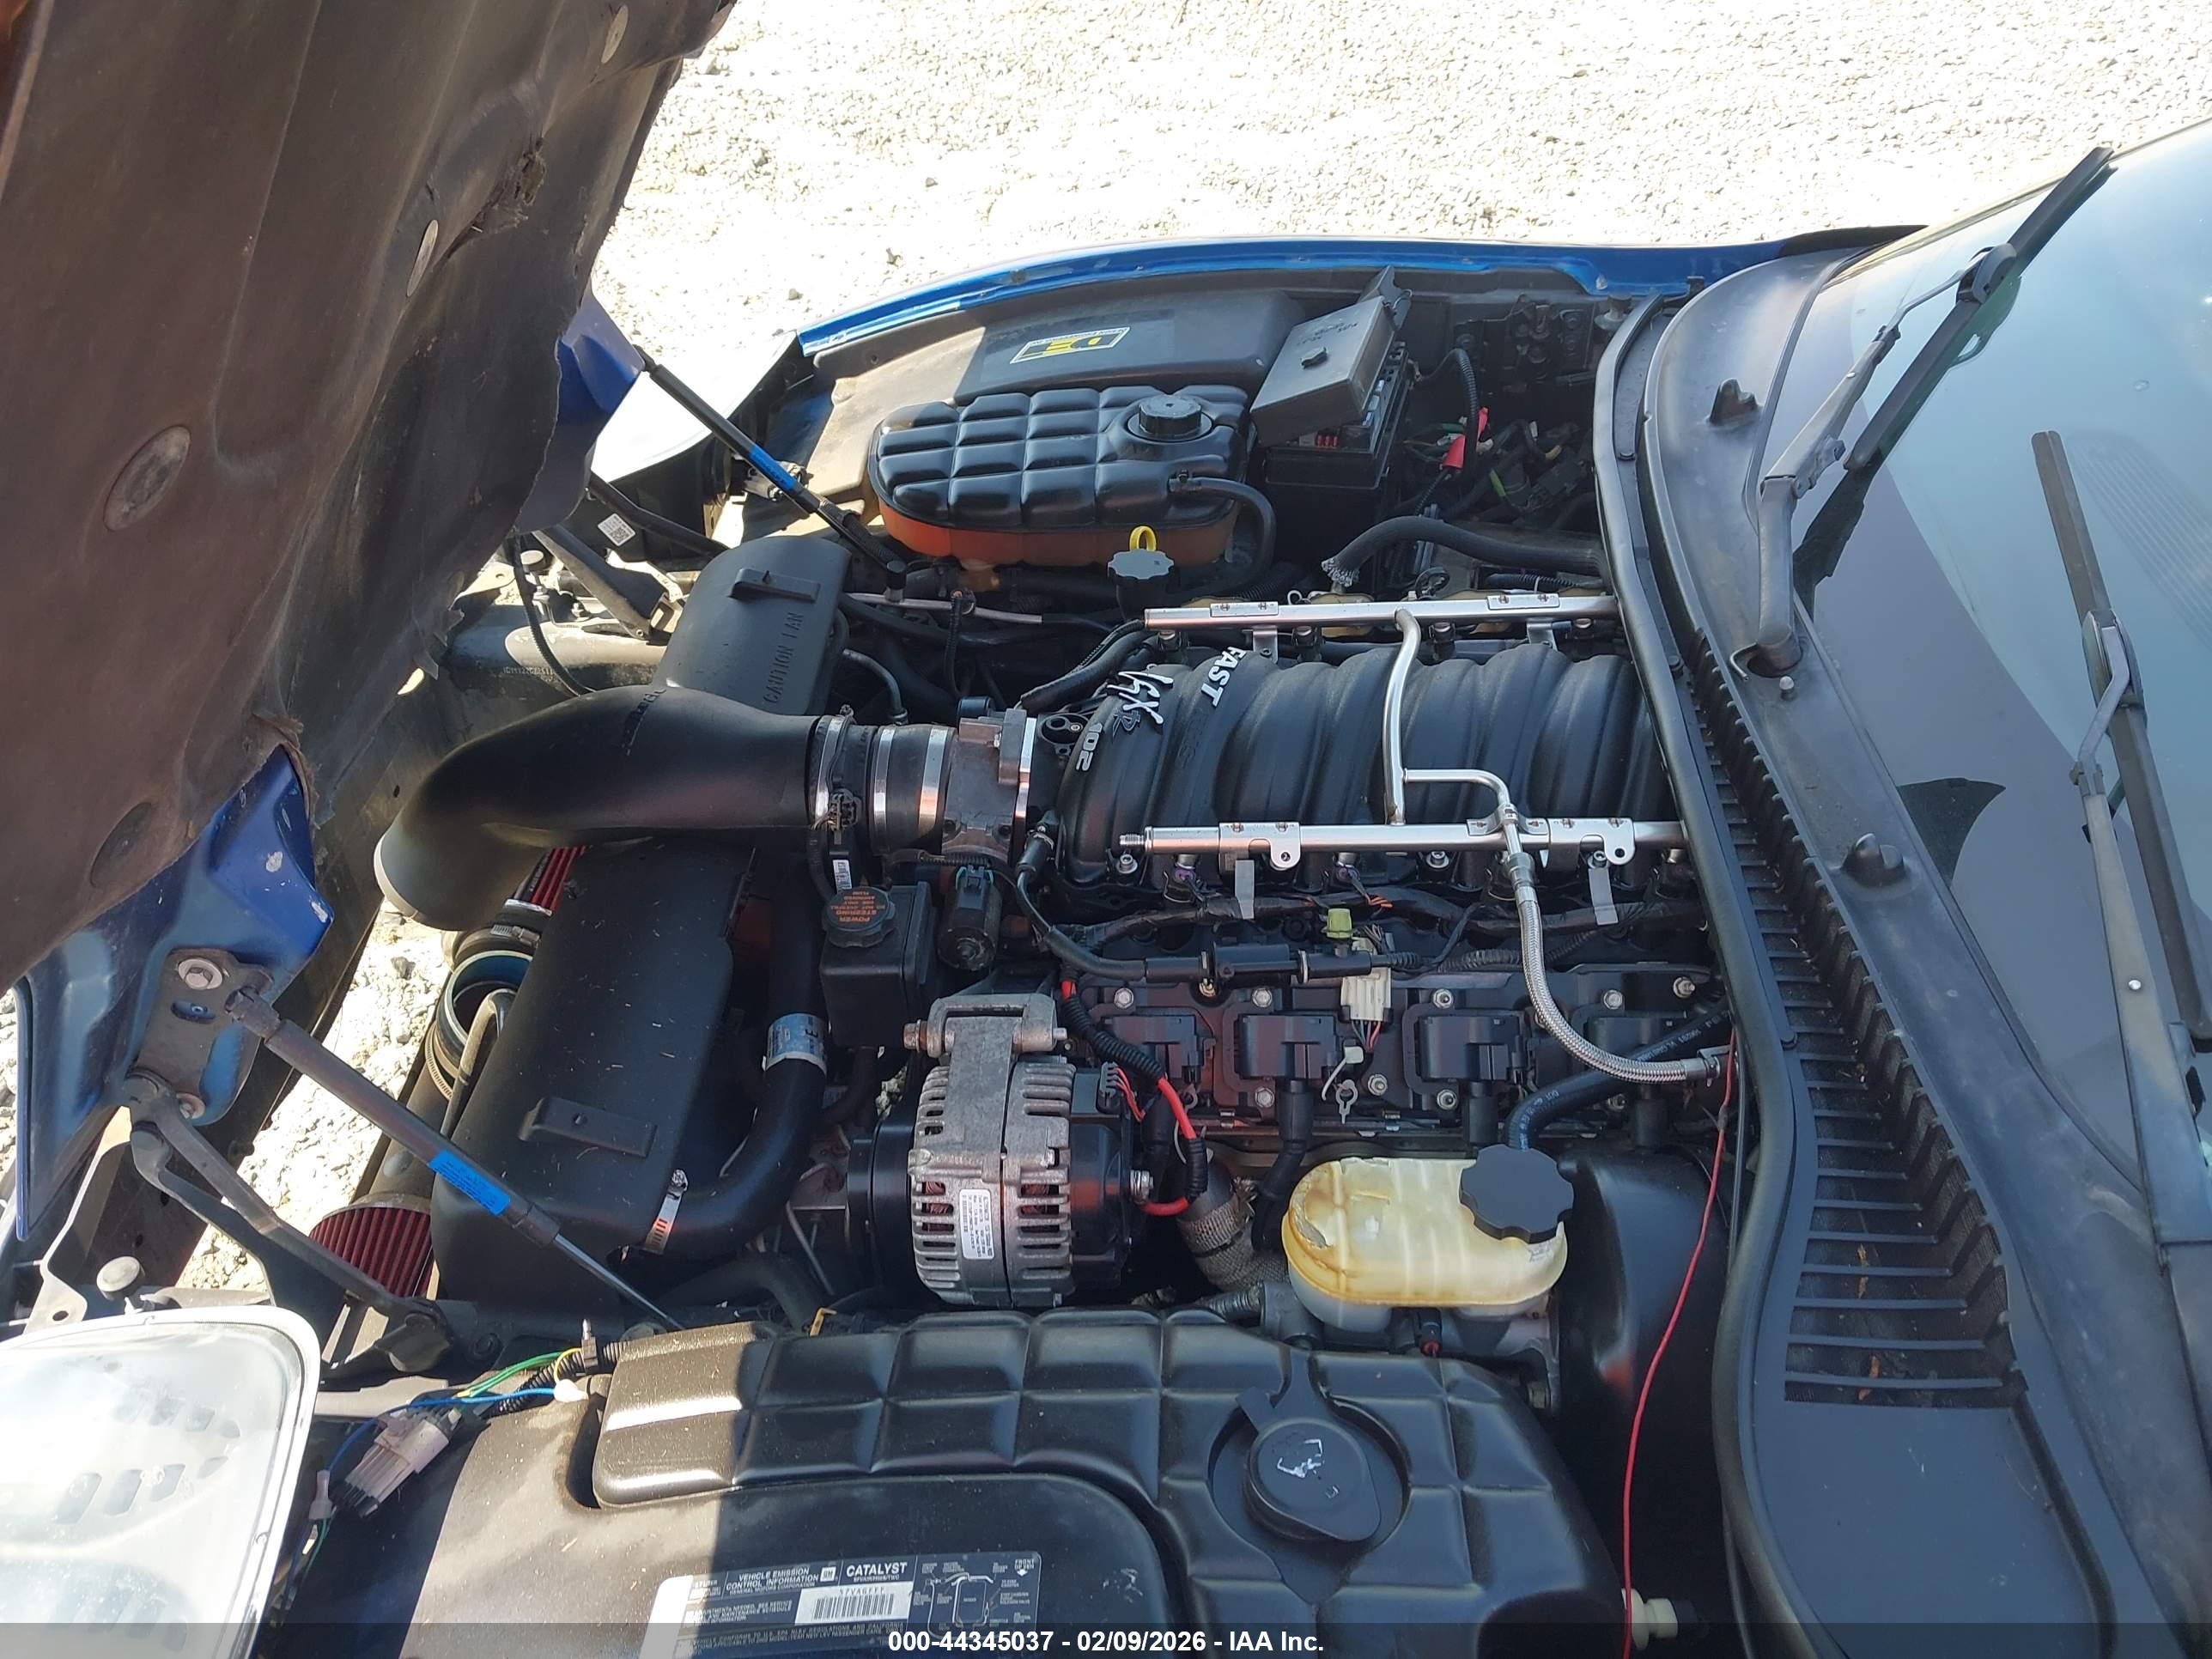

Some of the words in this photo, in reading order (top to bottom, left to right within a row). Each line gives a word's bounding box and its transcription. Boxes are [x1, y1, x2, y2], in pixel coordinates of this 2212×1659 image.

[763, 645, 794, 703] CAUTION
[1200, 646, 1247, 707] FAST
[1075, 722, 1103, 771] 102
[726, 1580, 763, 1590] CONTROL
[766, 1573, 819, 1585] INFORMATION
[738, 1571, 770, 1582] VEHICLE
[773, 1567, 810, 1578] EMISSION
[846, 1562, 908, 1577] CATALYST
